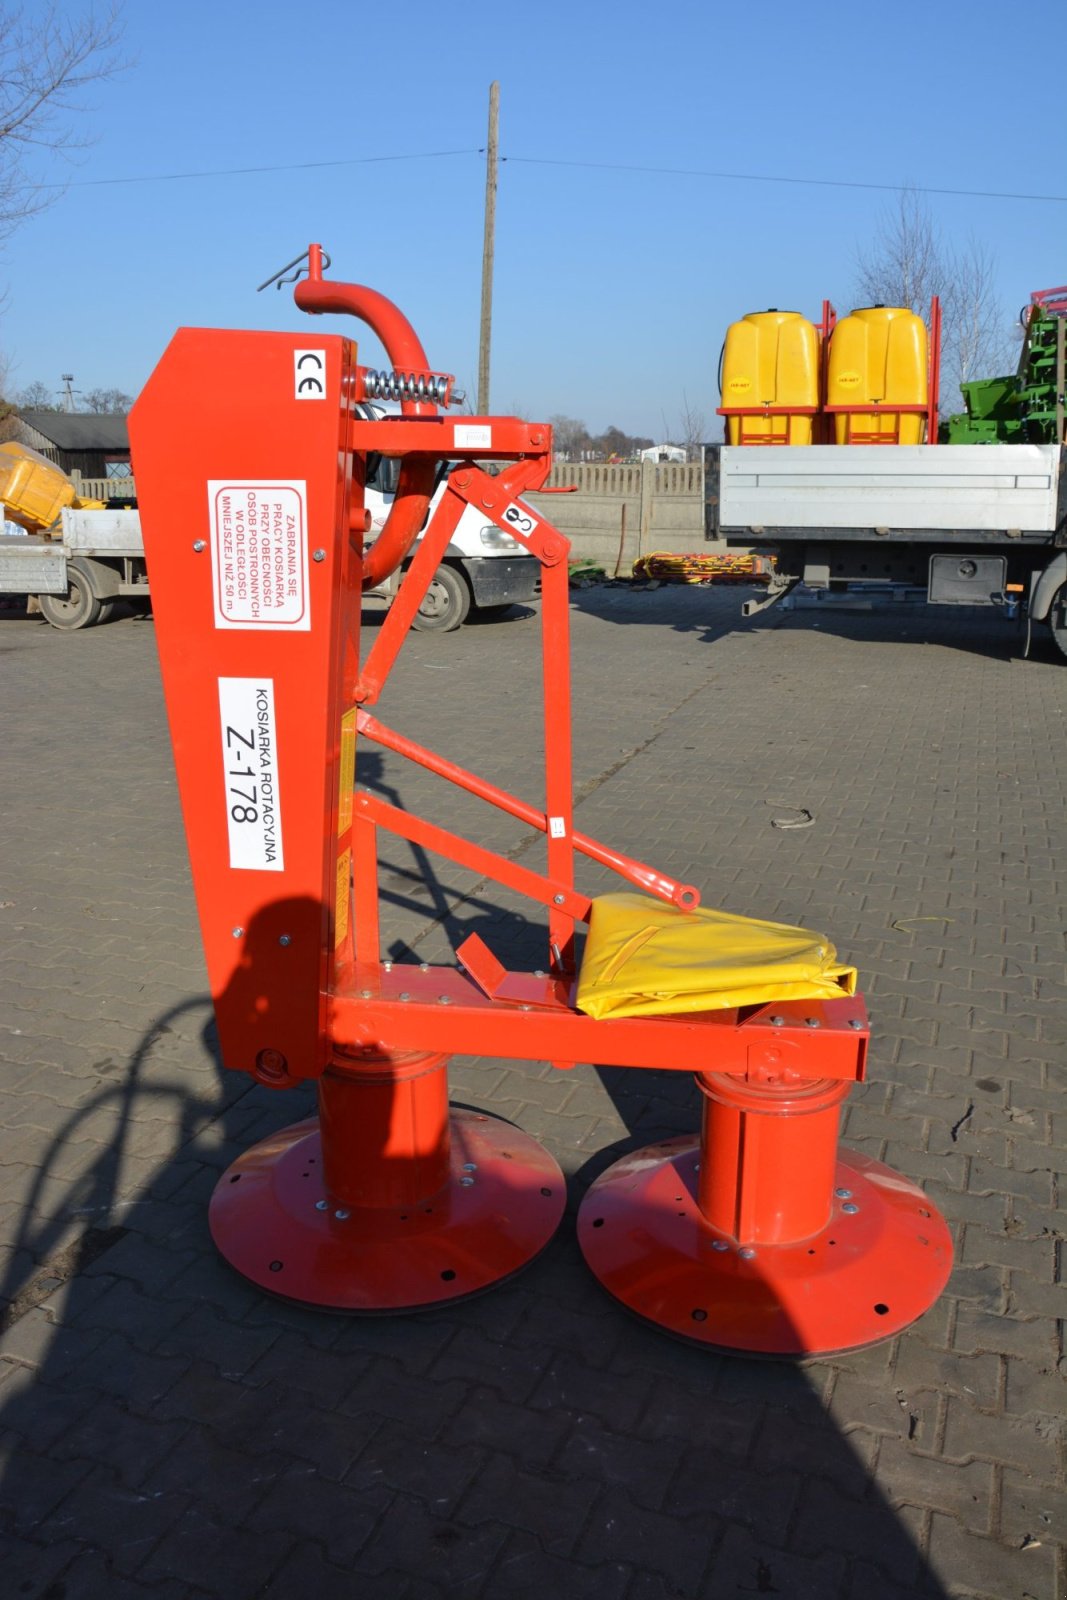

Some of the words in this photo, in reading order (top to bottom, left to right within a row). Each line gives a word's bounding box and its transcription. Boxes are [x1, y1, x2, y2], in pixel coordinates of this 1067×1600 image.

[222, 496, 232, 559] MNIEJSZEJ
[235, 510, 244, 521] W
[247, 492, 258, 526] OSÓB
[261, 504, 270, 535] PRZY
[273, 503, 283, 543] PRACY
[224, 563, 235, 581] NIŻ
[235, 525, 247, 600] ODLEGŁOŚCI
[249, 529, 259, 618] POSTRONNYCH
[262, 538, 272, 607] OBECNOŚCI
[286, 515, 296, 575] ZABRANIA
[226, 585, 234, 596] 50
[274, 547, 284, 608] KOSIARKĄ
[286, 579, 297, 596] SIĘ
[256, 689, 271, 768] KOSIARKA
[227, 726, 258, 824] Z-178
[260, 773, 276, 863] ROTACYJNA
